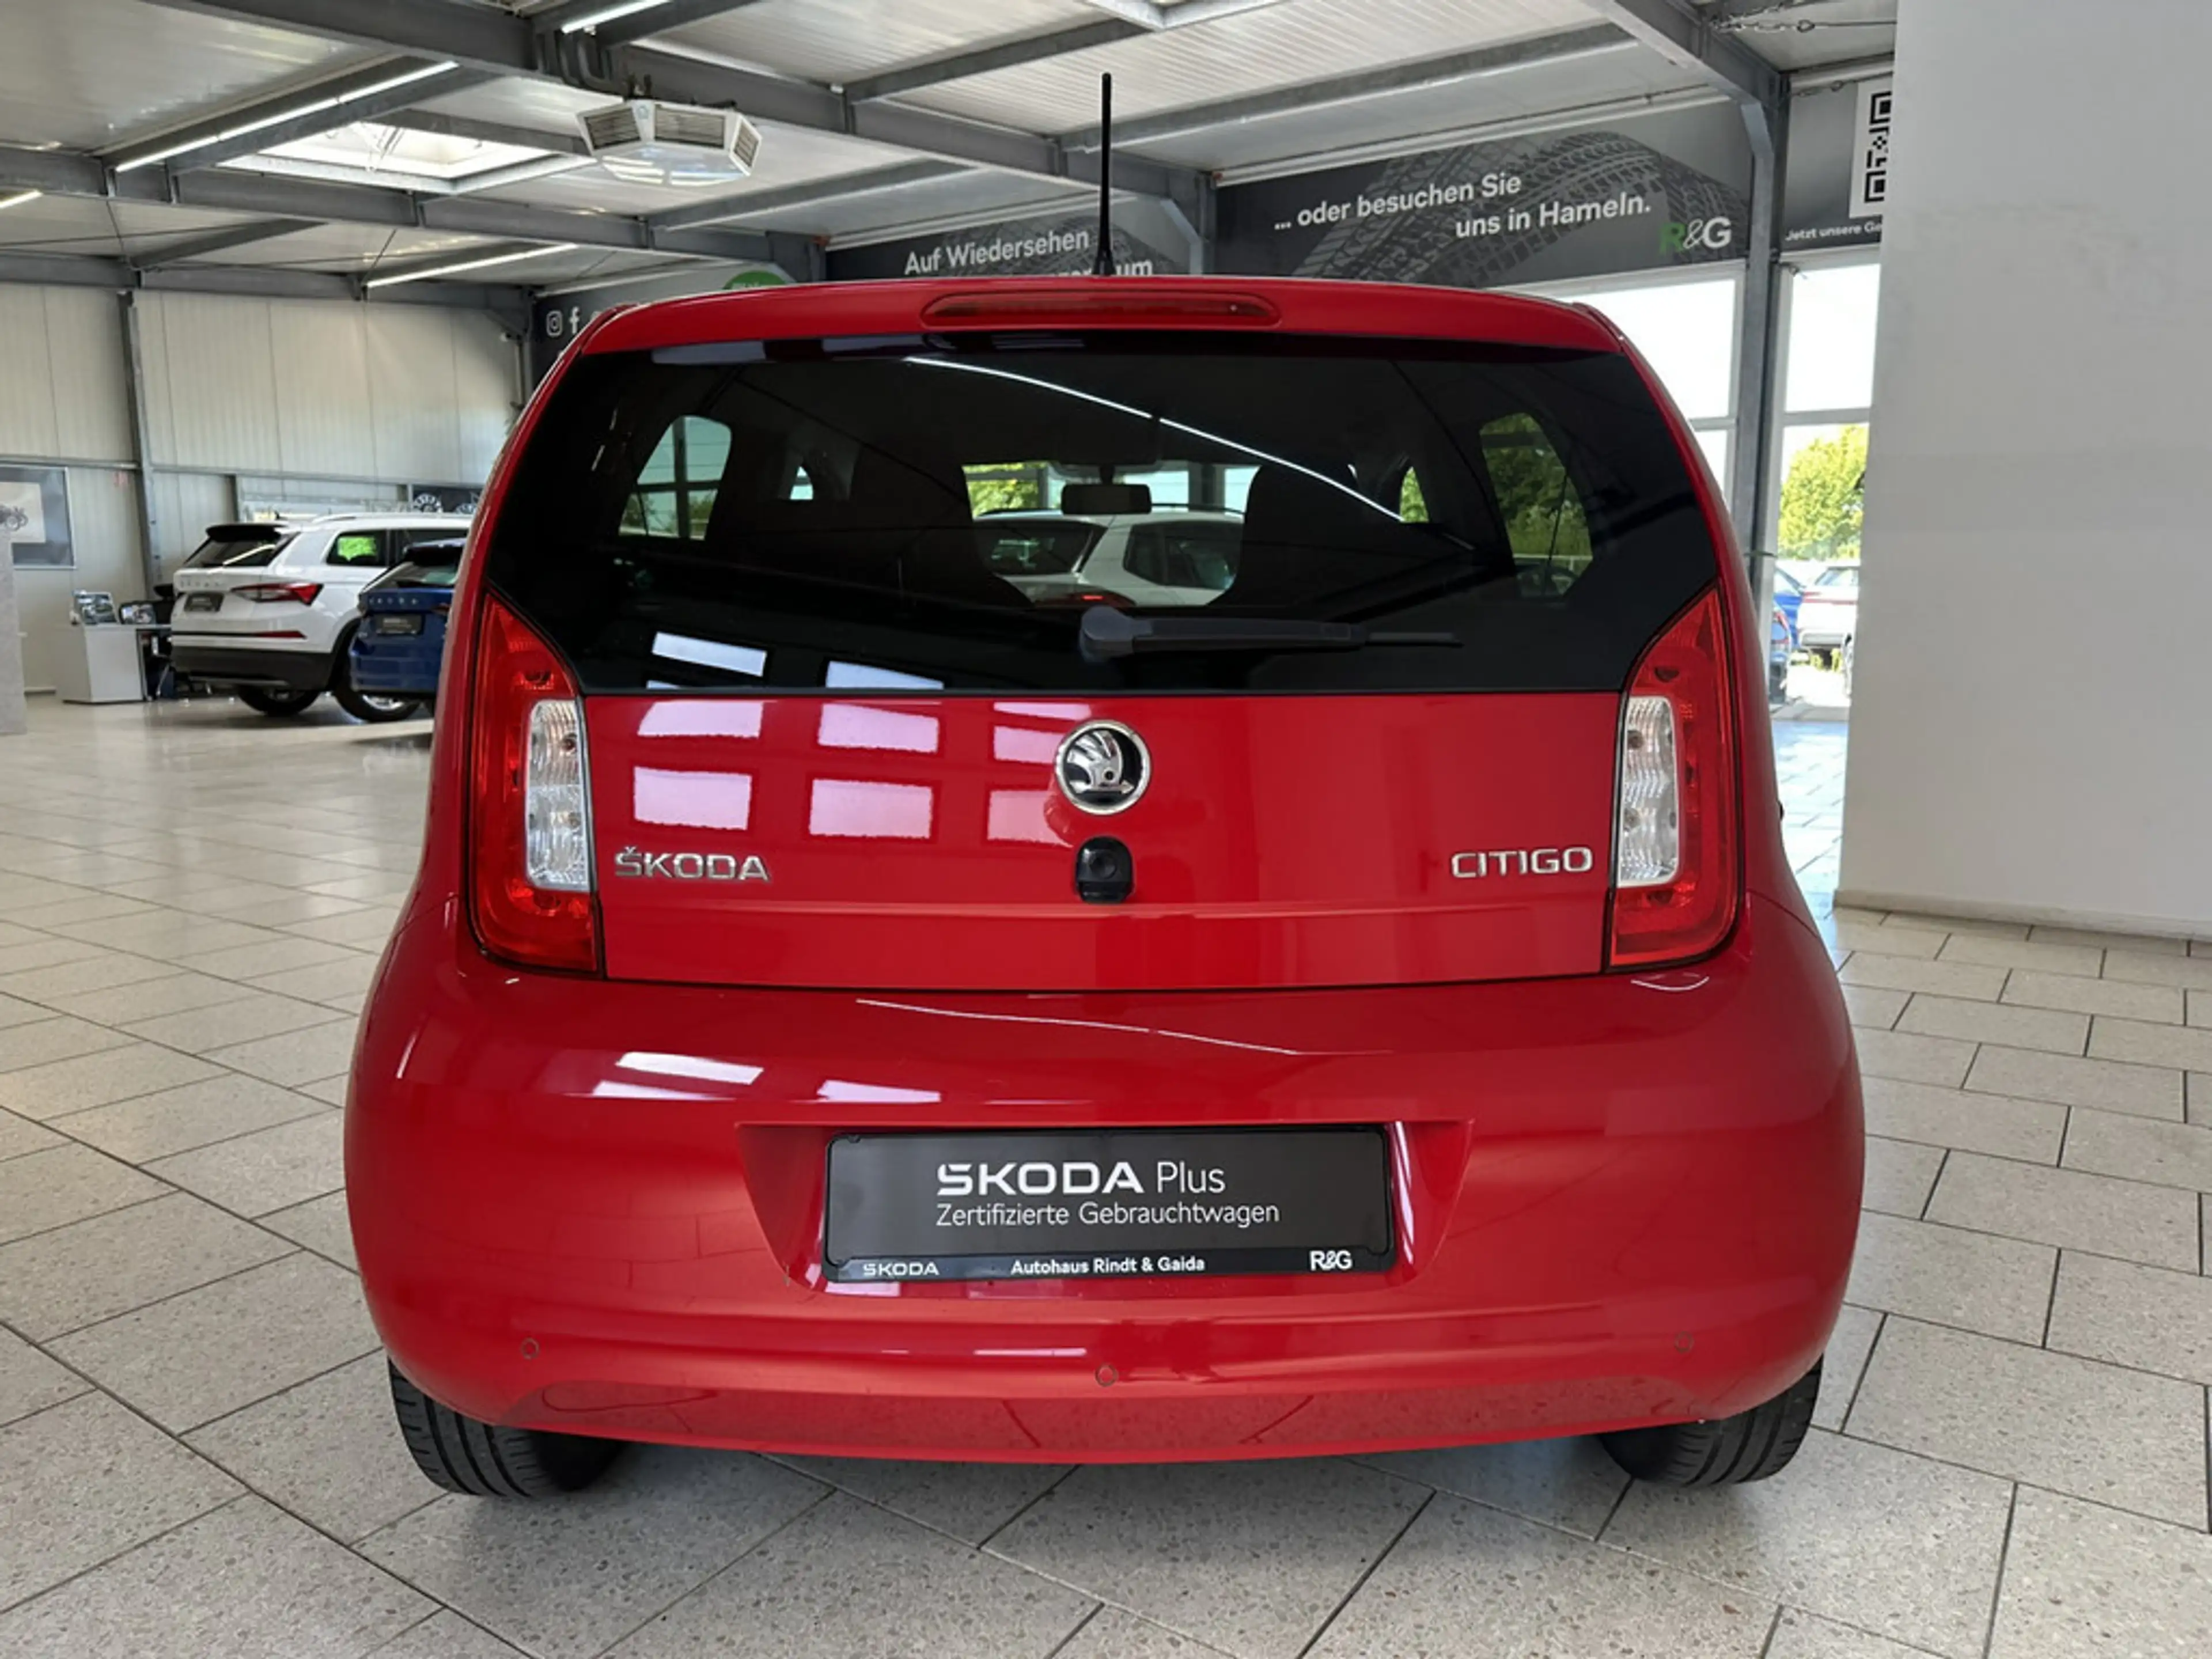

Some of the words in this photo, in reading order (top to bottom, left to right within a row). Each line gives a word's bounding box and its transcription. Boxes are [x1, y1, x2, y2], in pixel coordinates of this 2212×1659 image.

[1297, 202, 1350, 226] oder
[1356, 184, 1474, 217] besuchen
[1481, 172, 1522, 198] Sie
[1455, 217, 1501, 238] uns
[1508, 208, 1530, 231] in
[1539, 192, 1651, 227] Hameln.
[1659, 216, 1732, 256] R&G
[1785, 229, 1817, 241] Jetzt
[1819, 226, 1862, 237] unsere
[904, 248, 942, 275] Auf
[945, 230, 1090, 266] Wiedersehen
[615, 846, 768, 881] ŠKODA
[1451, 847, 1593, 878] CITIGO
[936, 1161, 1145, 1196] SKODA
[1157, 1160, 1226, 1194] Plus
[936, 1203, 1070, 1226] Zertifizierte
[1079, 1201, 1280, 1228] Gebrauchtwagen
[863, 1261, 940, 1276] SKODA
[1010, 1259, 1089, 1275] Autohaus
[1093, 1256, 1137, 1274] Rindt
[1141, 1257, 1153, 1272] &
[1157, 1255, 1206, 1272] Gaida
[1309, 1249, 1353, 1271] R&G
